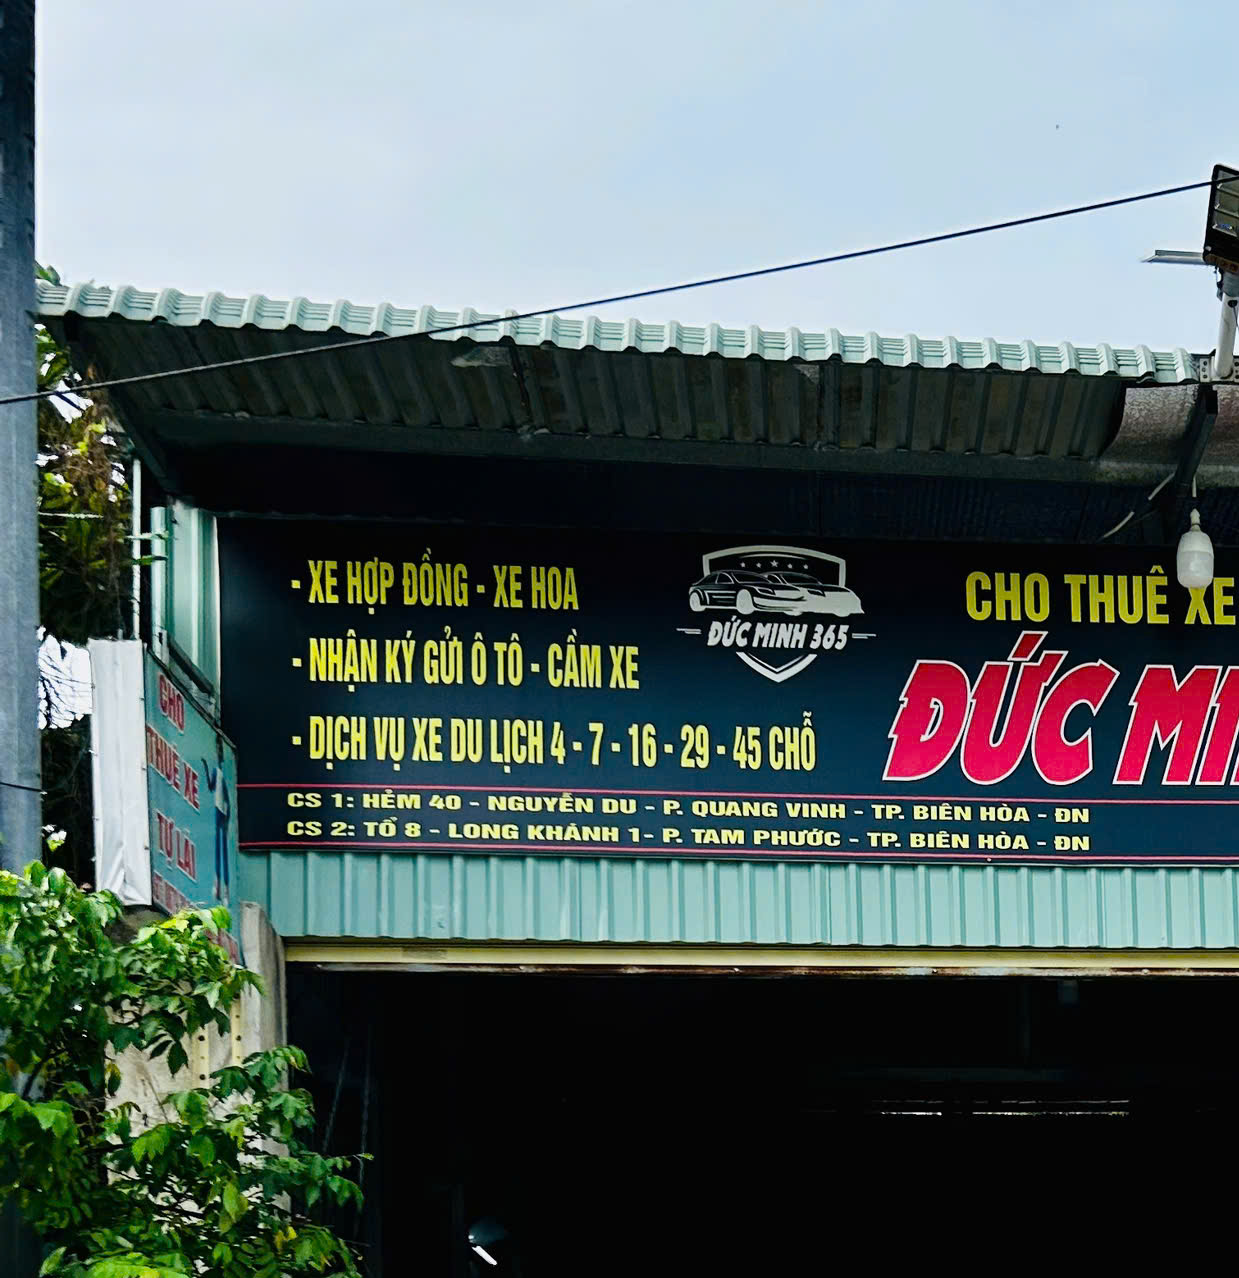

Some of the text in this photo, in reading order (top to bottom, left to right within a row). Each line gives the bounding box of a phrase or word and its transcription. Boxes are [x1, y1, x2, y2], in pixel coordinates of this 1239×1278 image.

[308, 560, 340, 604] XE
[346, 556, 395, 616] HỢP
[402, 548, 469, 608] ĐỒNG
[492, 564, 524, 608] XE
[530, 566, 580, 610] HOA
[966, 570, 1050, 622] CHO
[1064, 566, 1170, 624] THUÊ
[308, 628, 378, 692] NHẬN
[384, 630, 416, 684] KÝ
[423, 625, 464, 685] GỬI
[470, 632, 488, 686] Ô
[493, 632, 524, 687] TÔ
[548, 628, 602, 688] CẦM
[609, 645, 640, 690] XE
[706, 614, 849, 650] ĐỨC MINH 365
[158, 672, 184, 734] CHO
[882, 630, 1120, 786] ĐỨC
[309, 715, 367, 770] DỊCH
[372, 716, 406, 772] VỤ
[412, 717, 443, 762] XE
[450, 718, 483, 763] DU
[490, 718, 544, 774] LỊCH
[552, 720, 566, 765] 4
[588, 722, 604, 766] 7
[628, 722, 658, 768] 16
[680, 726, 710, 770] 29
[732, 726, 762, 770] 45
[768, 710, 816, 772] CHỖ
[183, 758, 200, 814] XE
[286, 792, 322, 808] CS
[330, 793, 354, 808] 1:
[362, 788, 420, 810] HẺM
[428, 794, 462, 810] 40
[487, 792, 594, 814] NGUYỄN
[602, 798, 638, 815] DU
[662, 800, 684, 816] P.
[692, 800, 778, 818] QUANG
[786, 802, 846, 820] VINH
[871, 804, 905, 820] TP.
[913, 802, 972, 821] BIÊN
[980, 804, 1030, 822] HÒA
[1054, 808, 1090, 824] ĐN
[286, 820, 322, 836] CS
[330, 820, 356, 837] 2:
[363, 816, 398, 838] TỔ
[404, 822, 421, 838] 8
[448, 823, 520, 840] LONG
[662, 828, 684, 844] P.
[691, 828, 744, 846] TAM
[752, 828, 842, 848] PHƯỚC
[866, 832, 901, 848] TP.
[910, 830, 971, 849] BIÊN
[978, 832, 1030, 850] HÒA
[1054, 836, 1090, 852] ĐN
